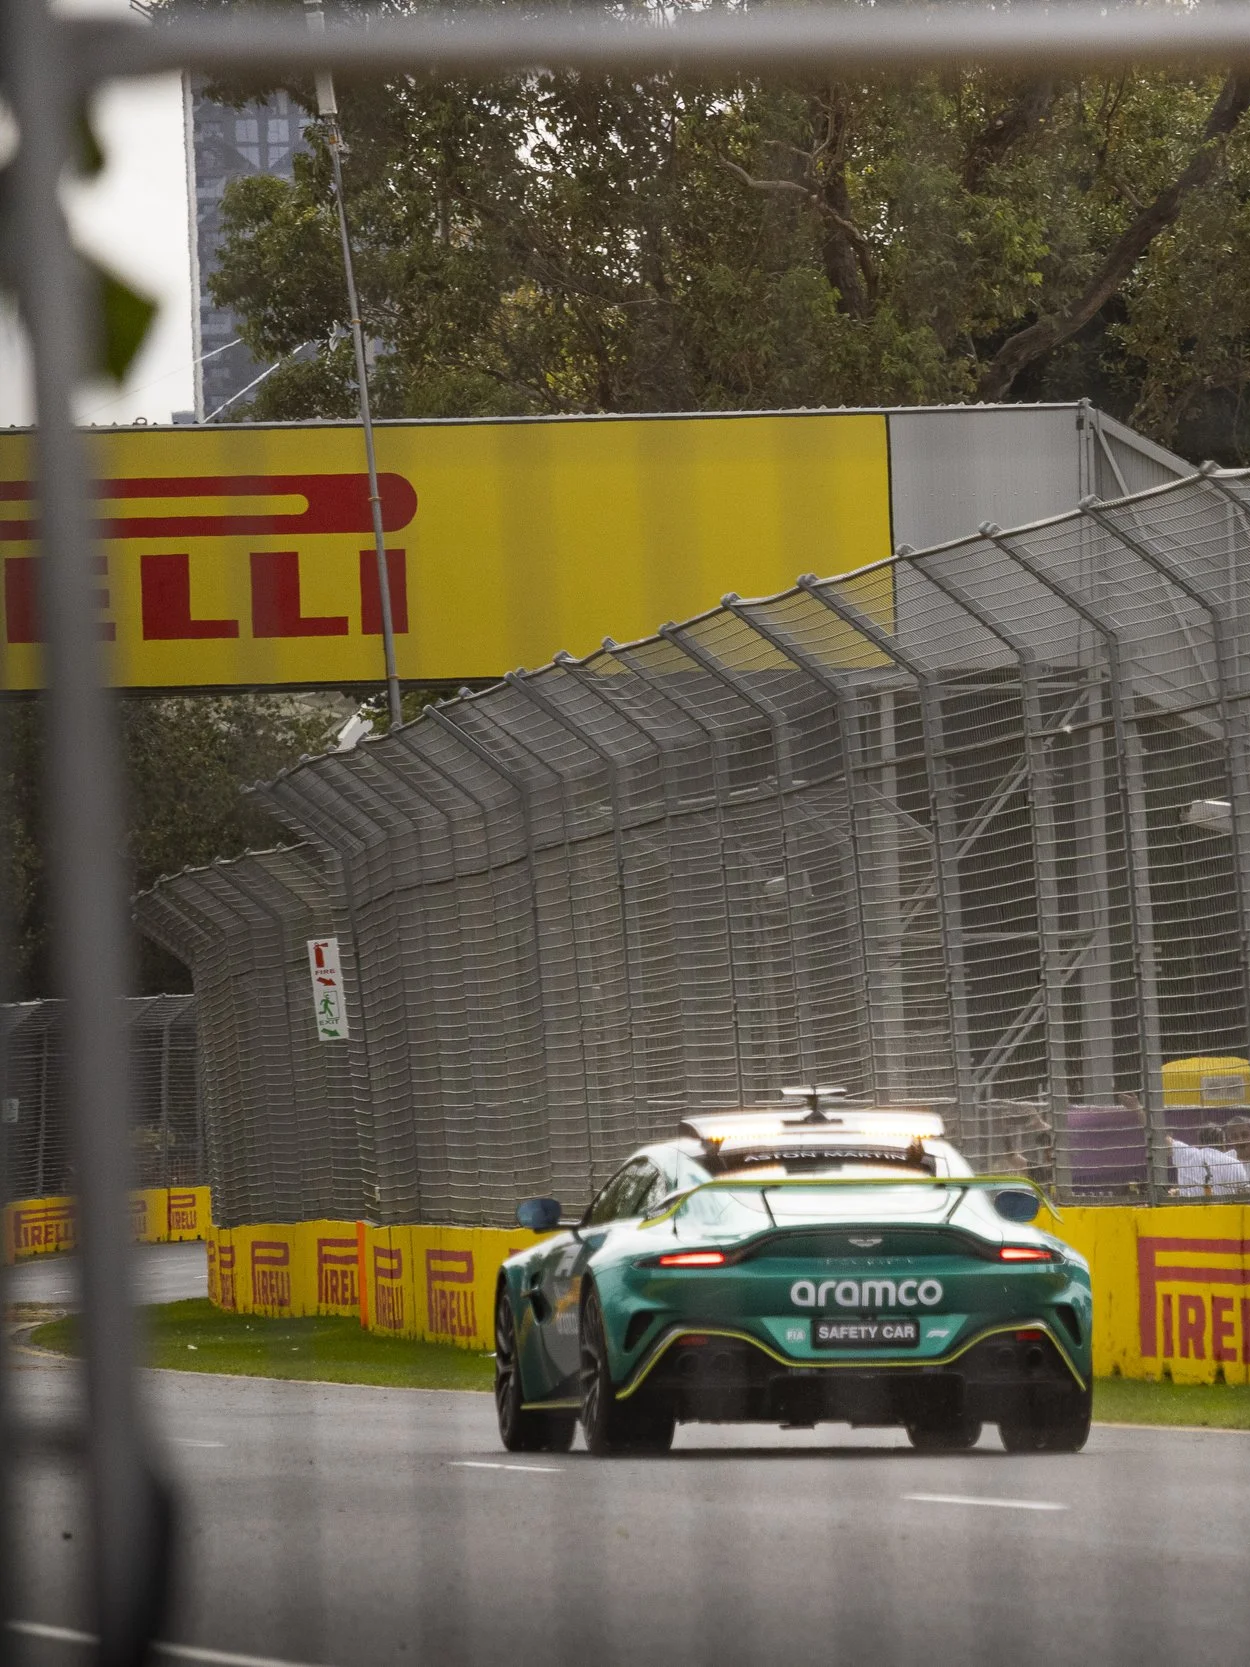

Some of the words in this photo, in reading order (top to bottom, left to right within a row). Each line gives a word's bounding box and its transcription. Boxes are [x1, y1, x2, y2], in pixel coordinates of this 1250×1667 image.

[744, 1151, 816, 1162] ASTON
[823, 1150, 908, 1161] MARTIN
[251, 1240, 291, 1306] PIRELLI
[426, 1249, 478, 1336] PIRELLI
[790, 1280, 943, 1307] aramco
[786, 1328, 806, 1341] FIA
[818, 1326, 878, 1339] SAFETY
[882, 1326, 915, 1339] CAR
